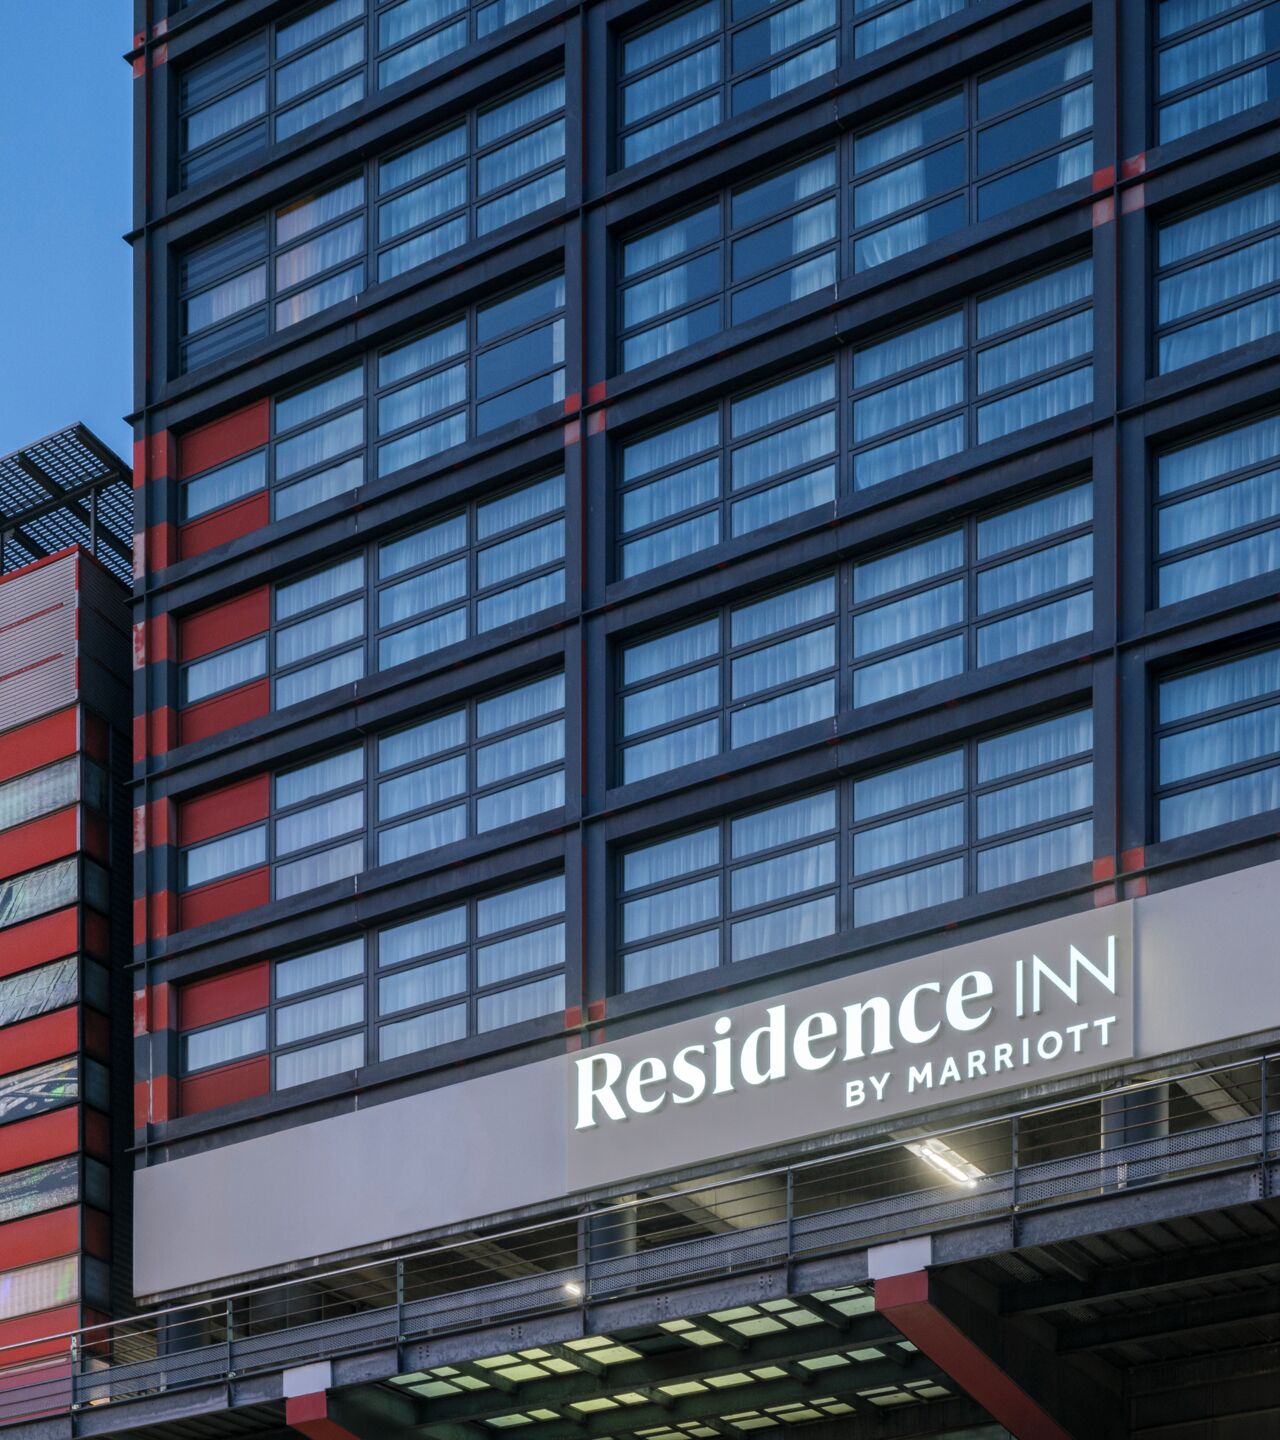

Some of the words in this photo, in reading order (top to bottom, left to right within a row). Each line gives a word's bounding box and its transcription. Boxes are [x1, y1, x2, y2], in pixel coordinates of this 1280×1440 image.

[574, 969, 994, 1132] Residence
[1015, 935, 1117, 1018] INN
[845, 1071, 893, 1109] BY
[908, 1016, 1117, 1094] MARRIOTT
